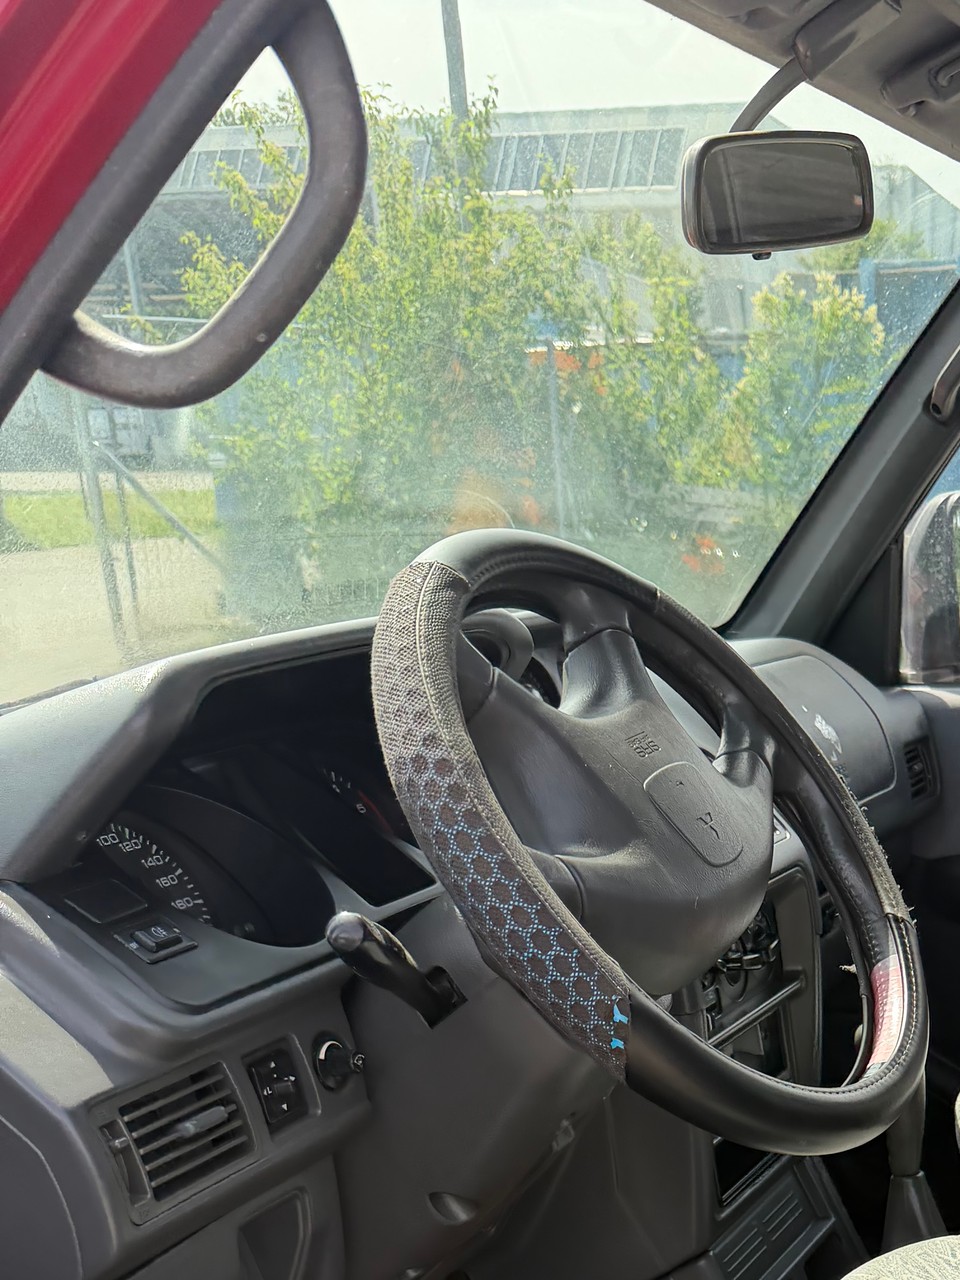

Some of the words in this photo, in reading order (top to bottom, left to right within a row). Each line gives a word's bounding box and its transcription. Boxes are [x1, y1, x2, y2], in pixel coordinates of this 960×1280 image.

[96, 833, 119, 847] 100
[119, 839, 142, 853] 120
[141, 855, 164, 869] 140
[156, 874, 178, 888] 160
[171, 897, 194, 910] 180
